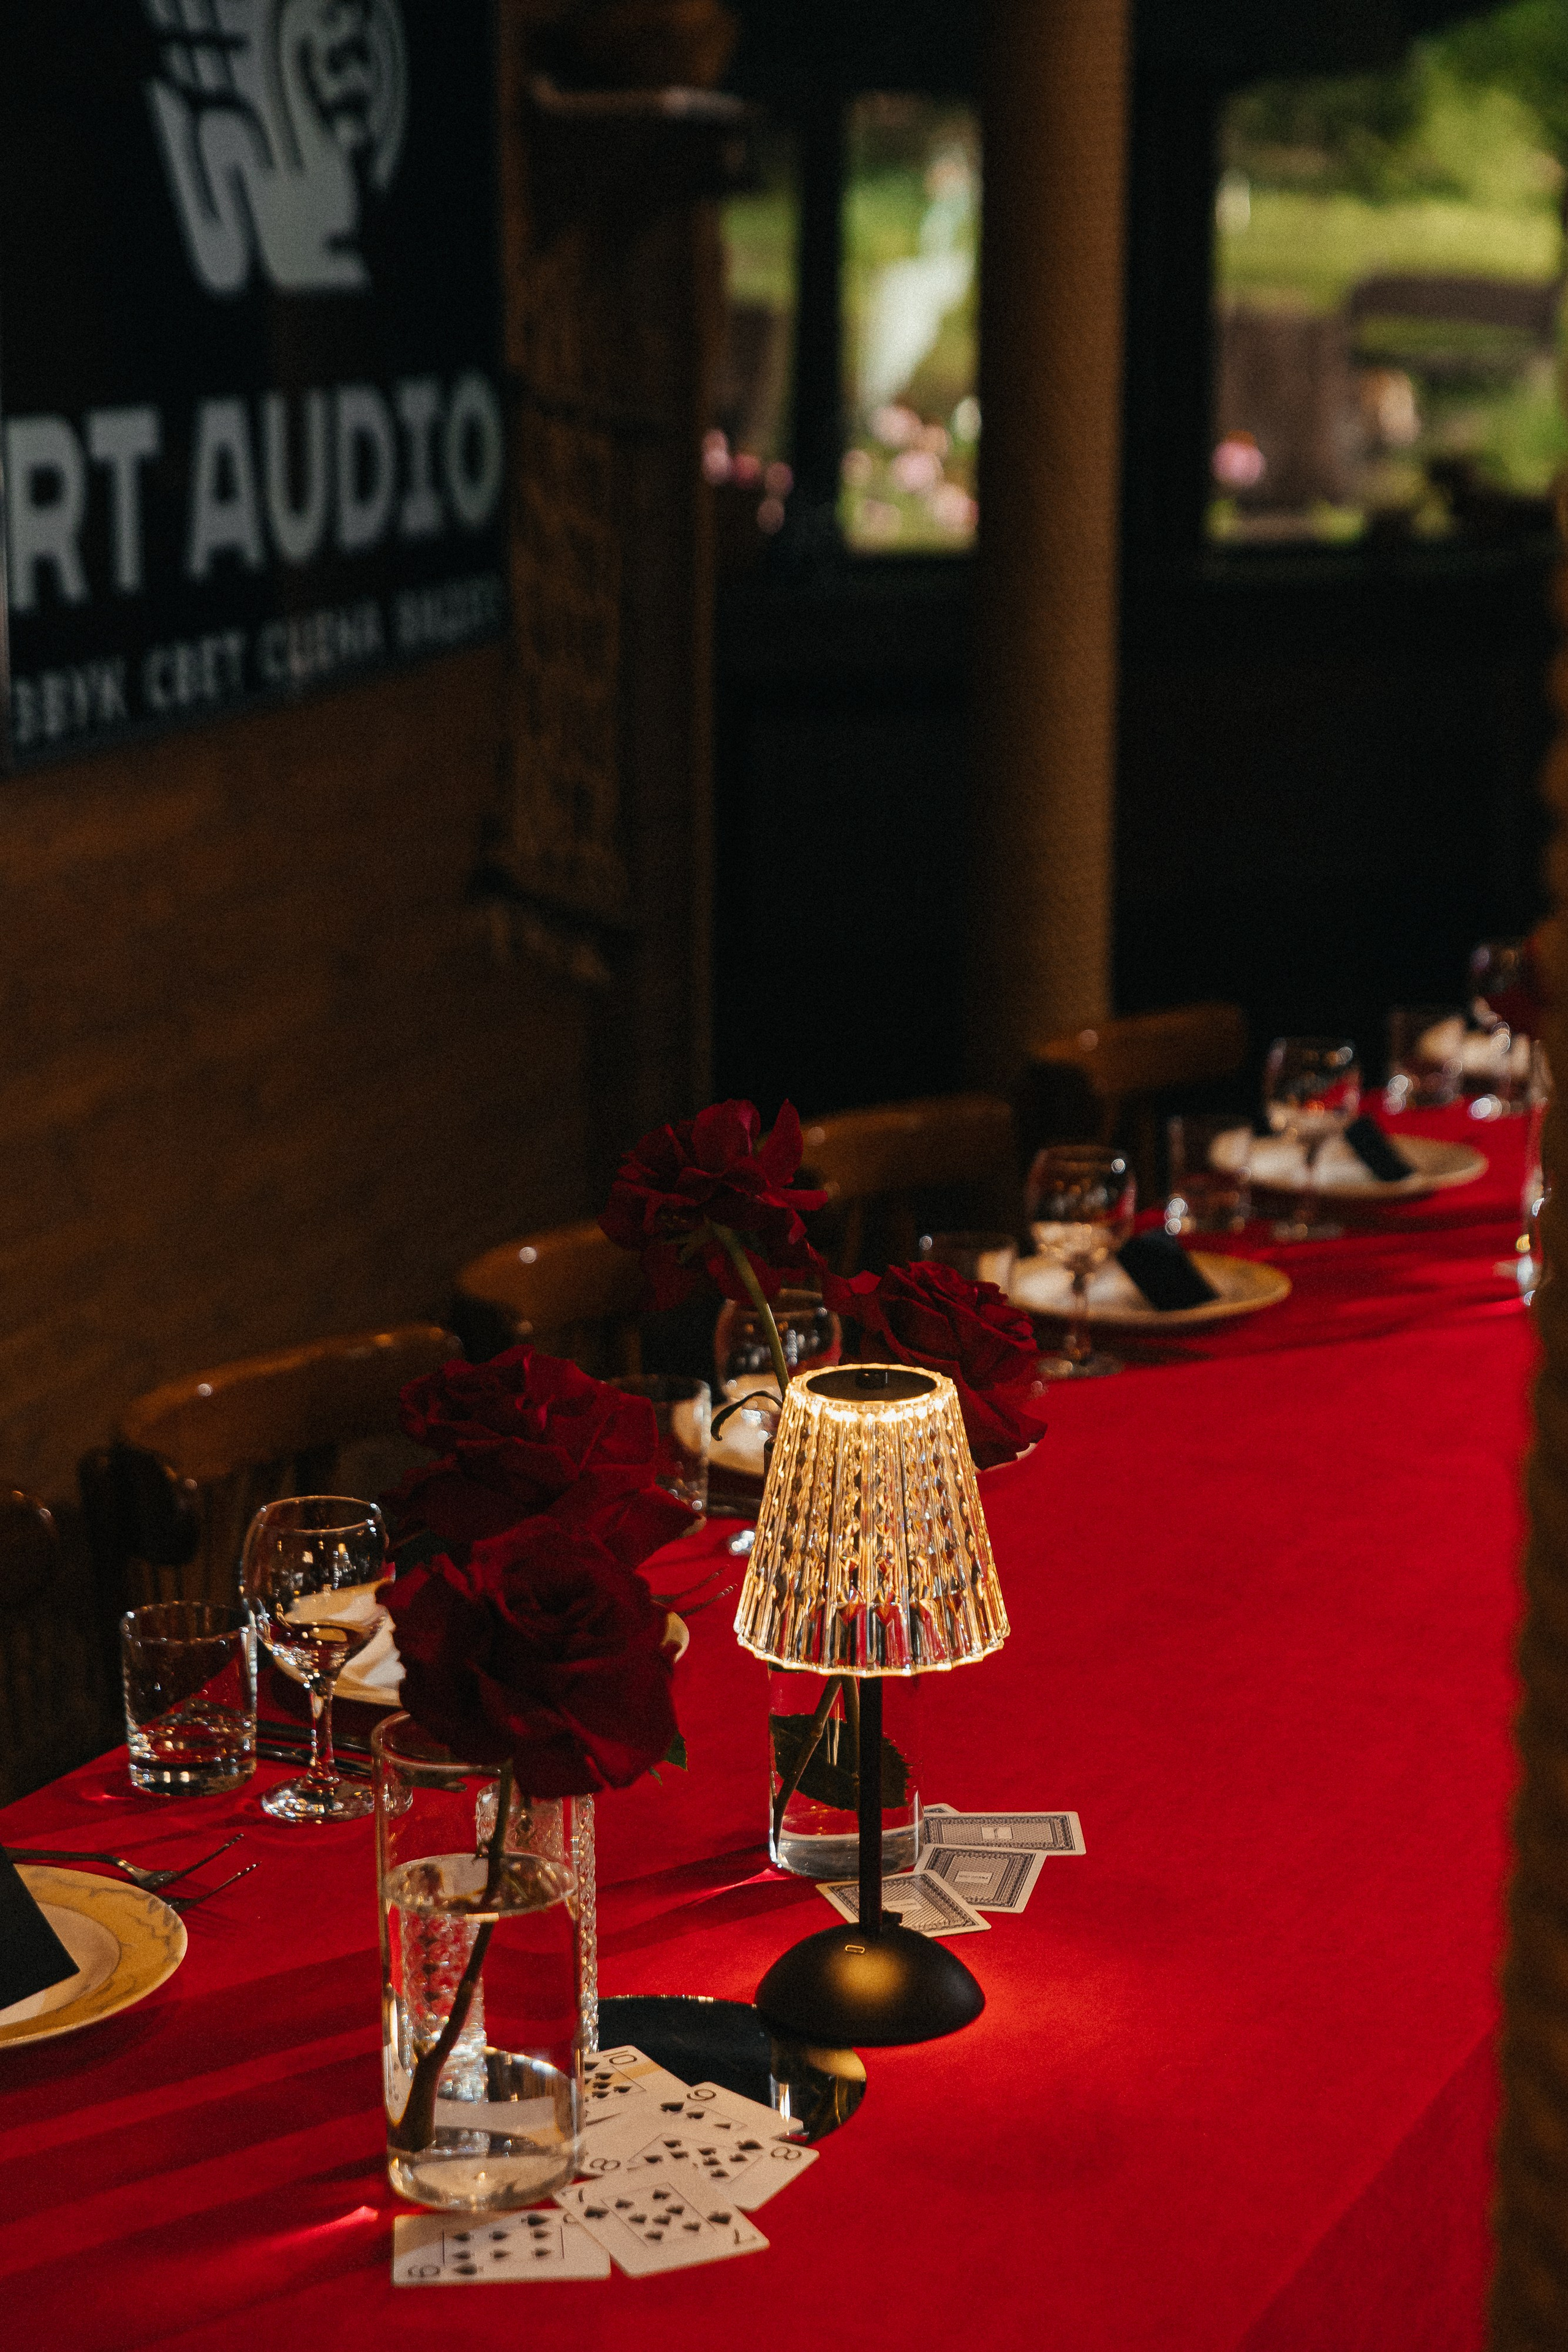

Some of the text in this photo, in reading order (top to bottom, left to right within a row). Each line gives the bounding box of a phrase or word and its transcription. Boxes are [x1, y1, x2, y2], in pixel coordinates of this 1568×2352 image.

[6, 369, 503, 611] RT AUDIO
[770, 2146, 802, 2160] 8
[589, 2157, 620, 2171] 8
